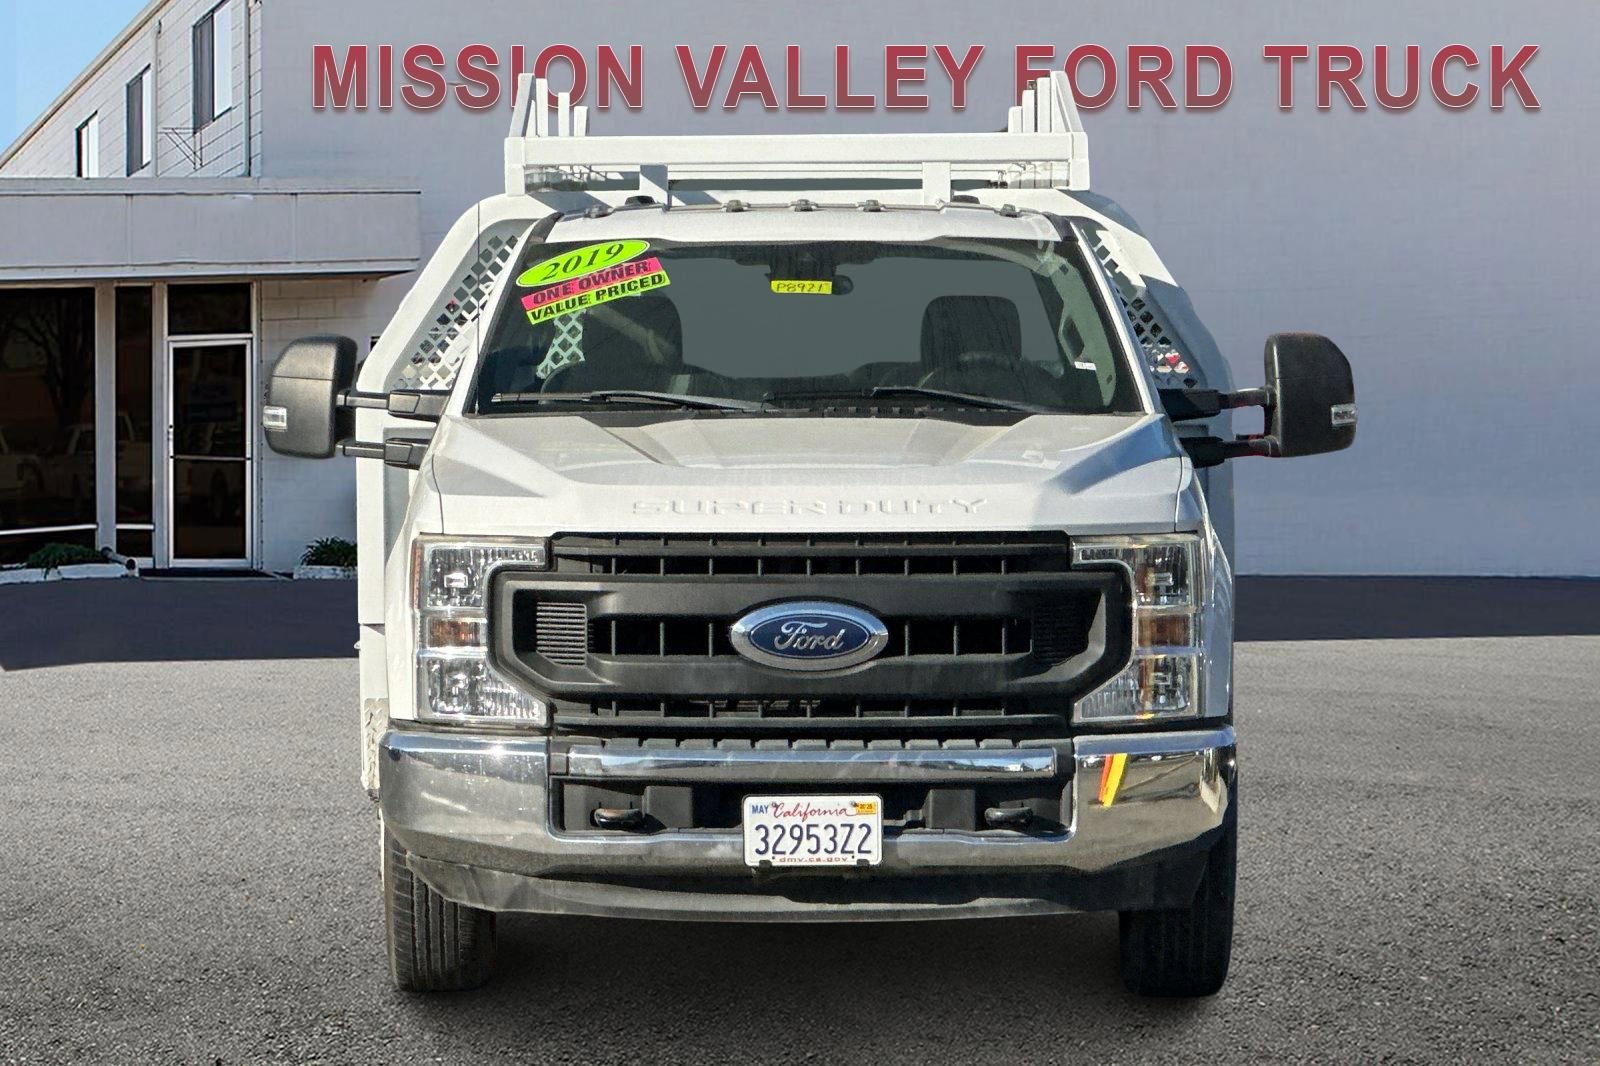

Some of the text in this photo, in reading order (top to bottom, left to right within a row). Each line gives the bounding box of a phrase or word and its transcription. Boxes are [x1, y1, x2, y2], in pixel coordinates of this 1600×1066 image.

[311, 43, 1542, 109] MISSION VALLEY FORD TRUCK
[540, 243, 625, 281] 2019
[531, 273, 663, 320] VALUE PRICED
[533, 261, 649, 305] ONE OWNER
[774, 620, 846, 650] Ford
[751, 804, 769, 815] MAY
[771, 801, 857, 822] California
[754, 823, 872, 856] 32953Z2
